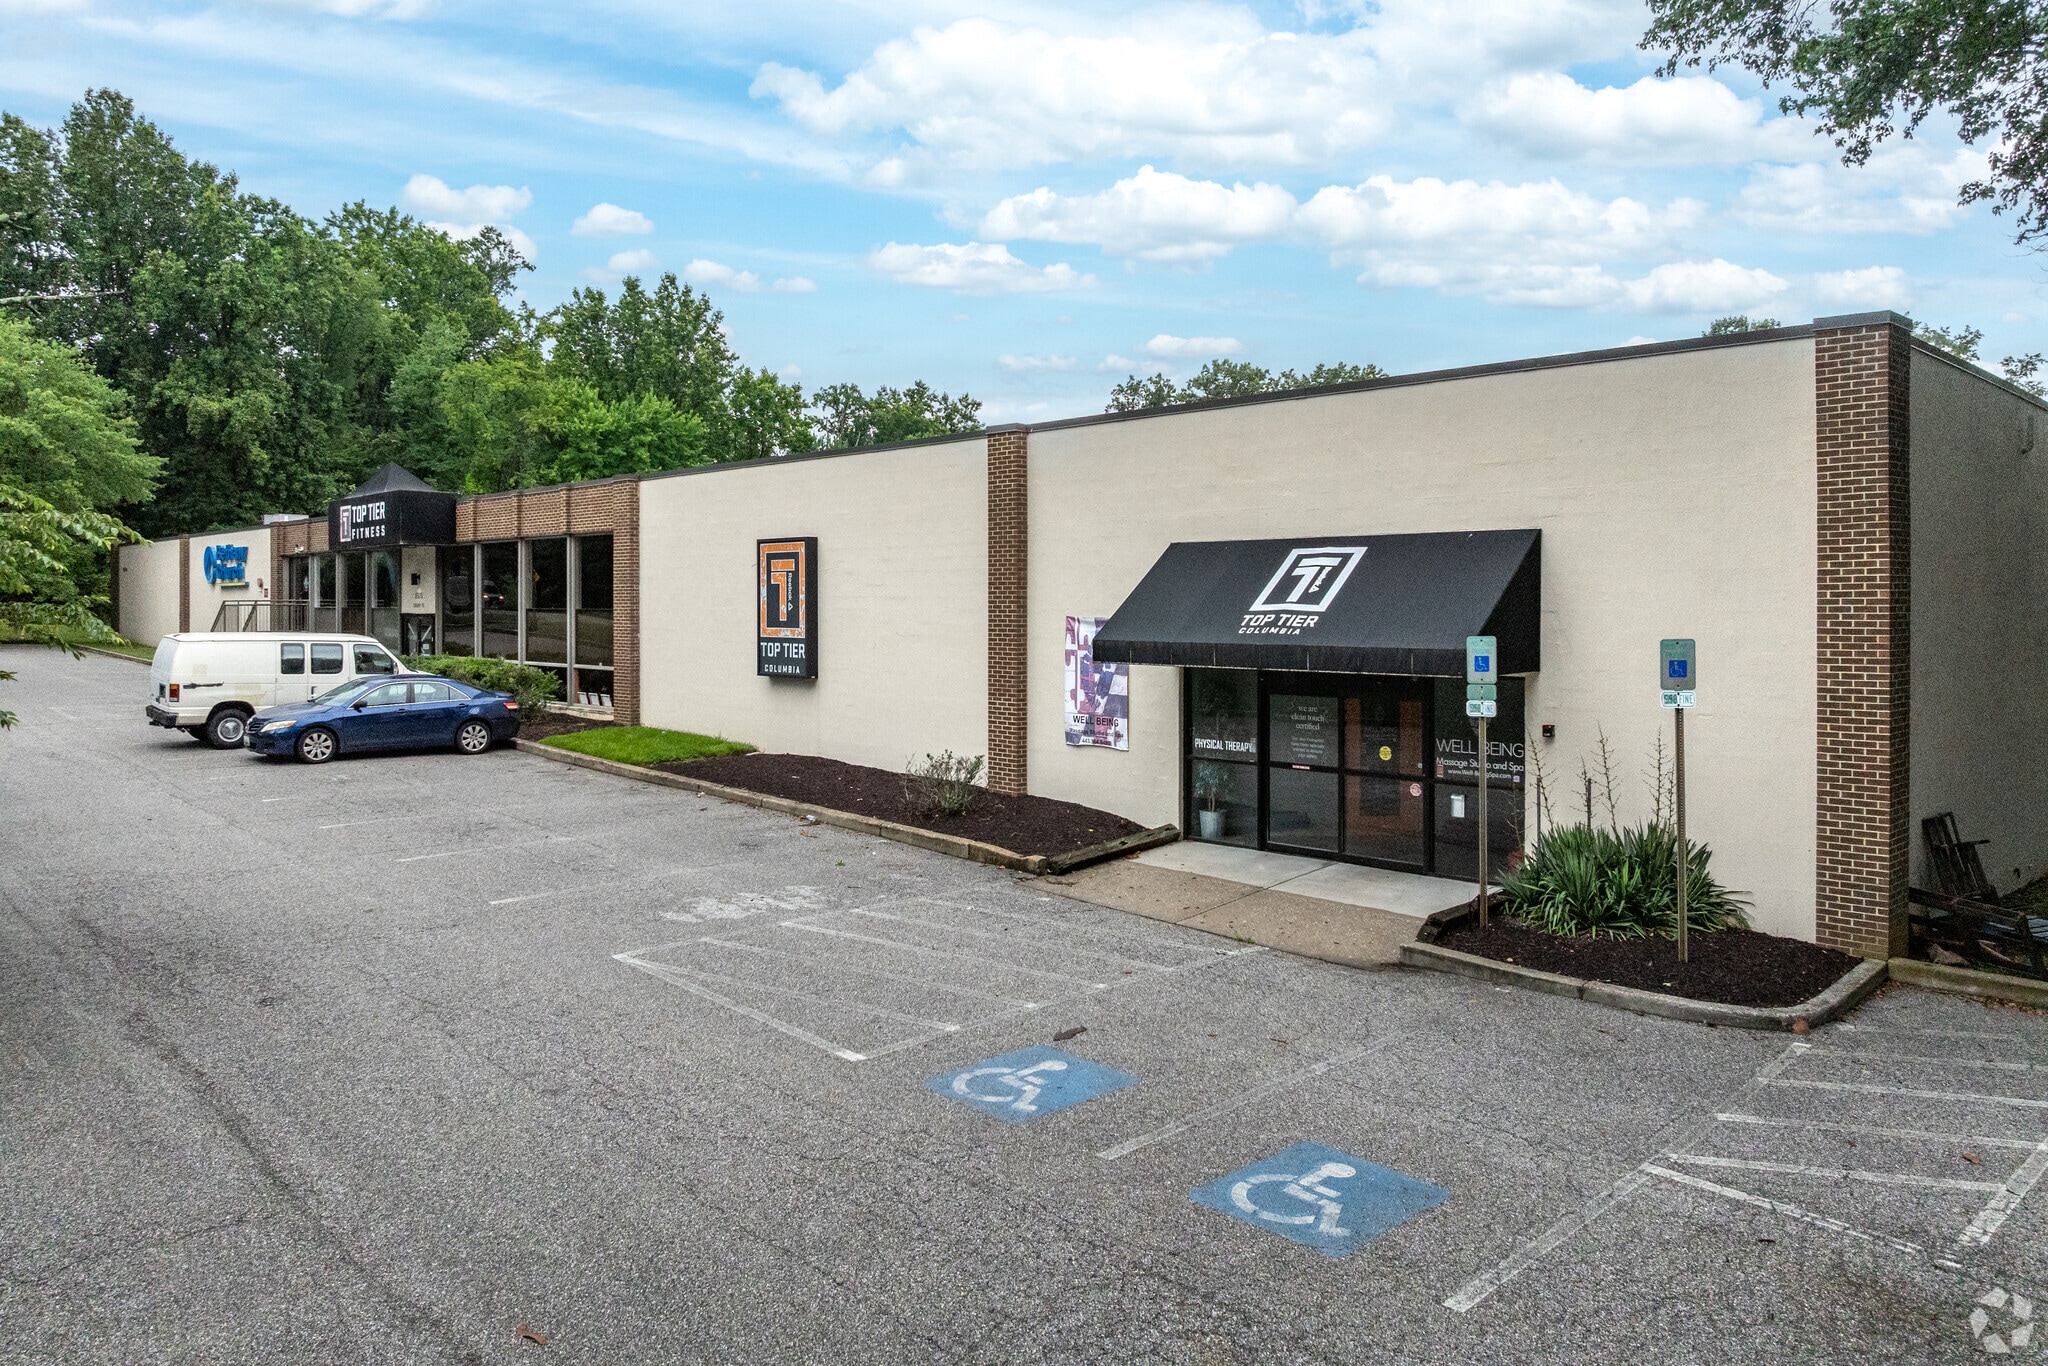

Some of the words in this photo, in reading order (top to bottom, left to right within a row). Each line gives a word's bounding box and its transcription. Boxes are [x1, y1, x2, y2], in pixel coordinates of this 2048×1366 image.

[351, 505, 367, 523] TOP
[367, 501, 386, 521] TIER
[351, 525, 386, 540] FITNESS
[1240, 614, 1276, 626] TOP
[1277, 614, 1320, 628] TIER
[1238, 627, 1301, 635] COLUMBIA
[760, 642, 781, 658] TOP
[783, 642, 806, 659] TIER
[764, 664, 801, 674] COLUMBIA
[1678, 694, 1693, 705] FINE
[1072, 715, 1094, 725] WELL
[1096, 717, 1119, 727] BEING
[1291, 712, 1307, 721] clean
[1307, 714, 1325, 723] touch
[1295, 721, 1320, 731] certified
[1194, 738, 1223, 750] PHYSICAL
[1225, 740, 1252, 752] THERAPY
[1436, 738, 1477, 754] WELL
[1436, 757, 1468, 769] Massage
[1469, 758, 1491, 769] Stuo
[1493, 760, 1507, 770] and
[1508, 761, 1524, 773] Spa
[1447, 769, 1512, 779] www.Well-BegSpa.com
